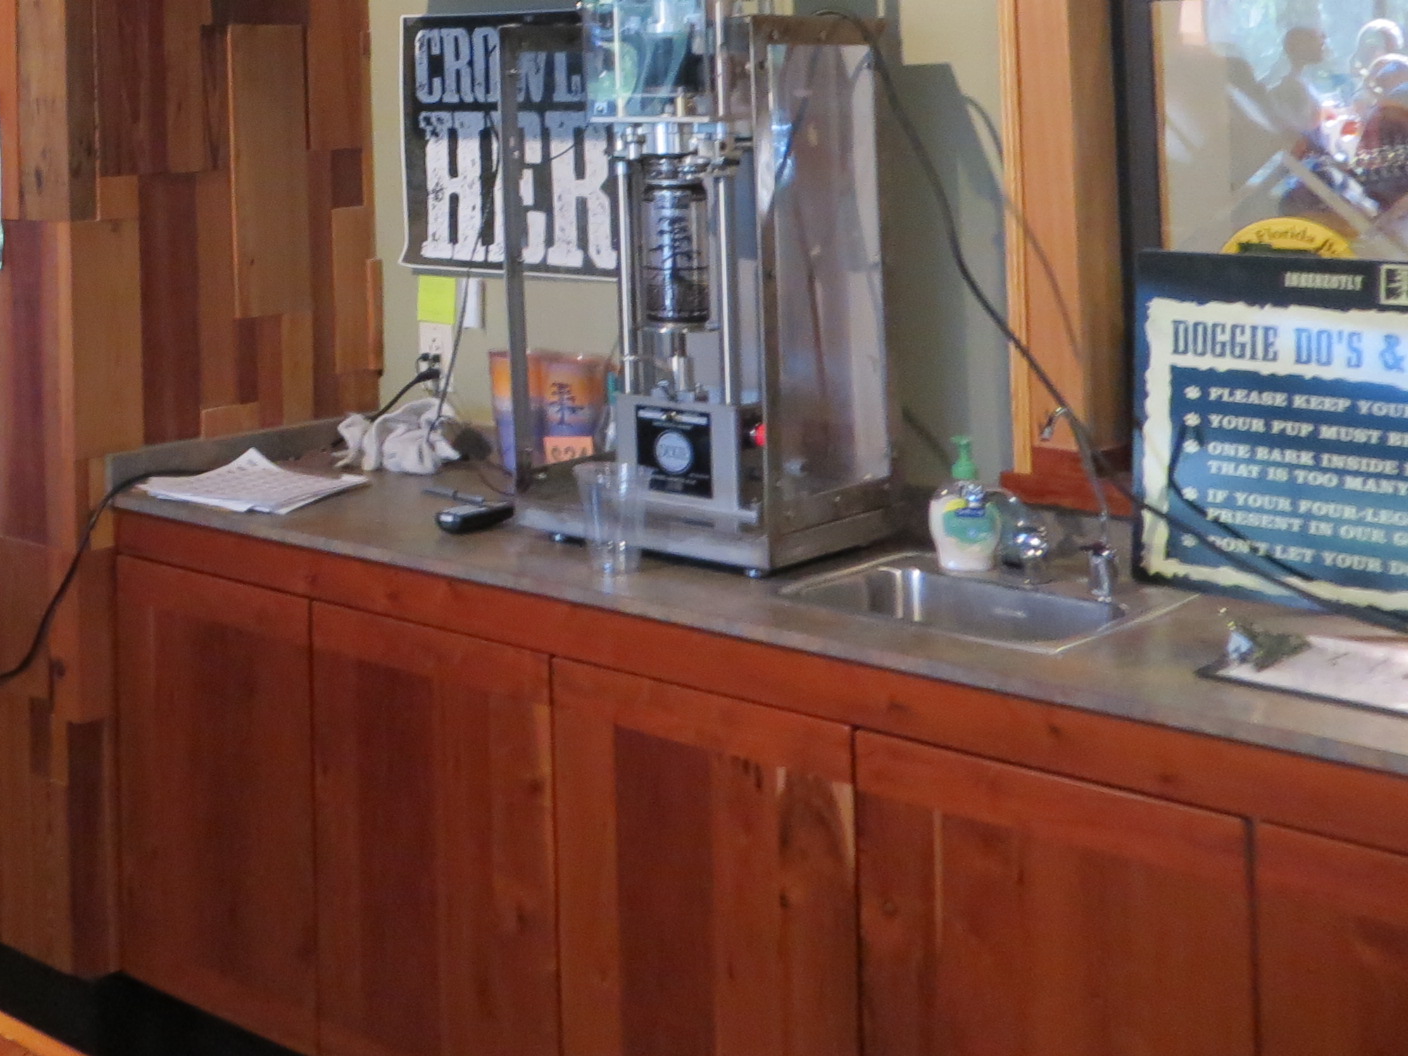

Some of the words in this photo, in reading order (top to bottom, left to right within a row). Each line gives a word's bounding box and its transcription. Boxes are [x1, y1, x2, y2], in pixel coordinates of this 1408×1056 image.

[1170, 319, 1279, 363] DOGGIE
[1294, 327, 1364, 369] DO'S
[1378, 333, 1406, 373] &
[1208, 386, 1288, 407] PLEASE
[1292, 394, 1352, 412] KEEP
[1207, 413, 1266, 433] YOUR
[1270, 419, 1315, 438] PUP
[1318, 424, 1383, 443] MUST
[1207, 441, 1252, 459] ONE
[1255, 446, 1316, 466] BARK
[1320, 453, 1400, 475] INSIDE
[1207, 460, 1261, 479] THAT
[1266, 466, 1290, 482] IS
[1294, 469, 1340, 488] TOO
[1206, 488, 1229, 504] IF
[1233, 492, 1293, 512] YOUR
[1206, 507, 1305, 532] PRESENT
[1307, 520, 1335, 537] IN
[1338, 525, 1388, 544] OUR
[1273, 544, 1317, 564] LET
[1321, 550, 1384, 573] YOUR
